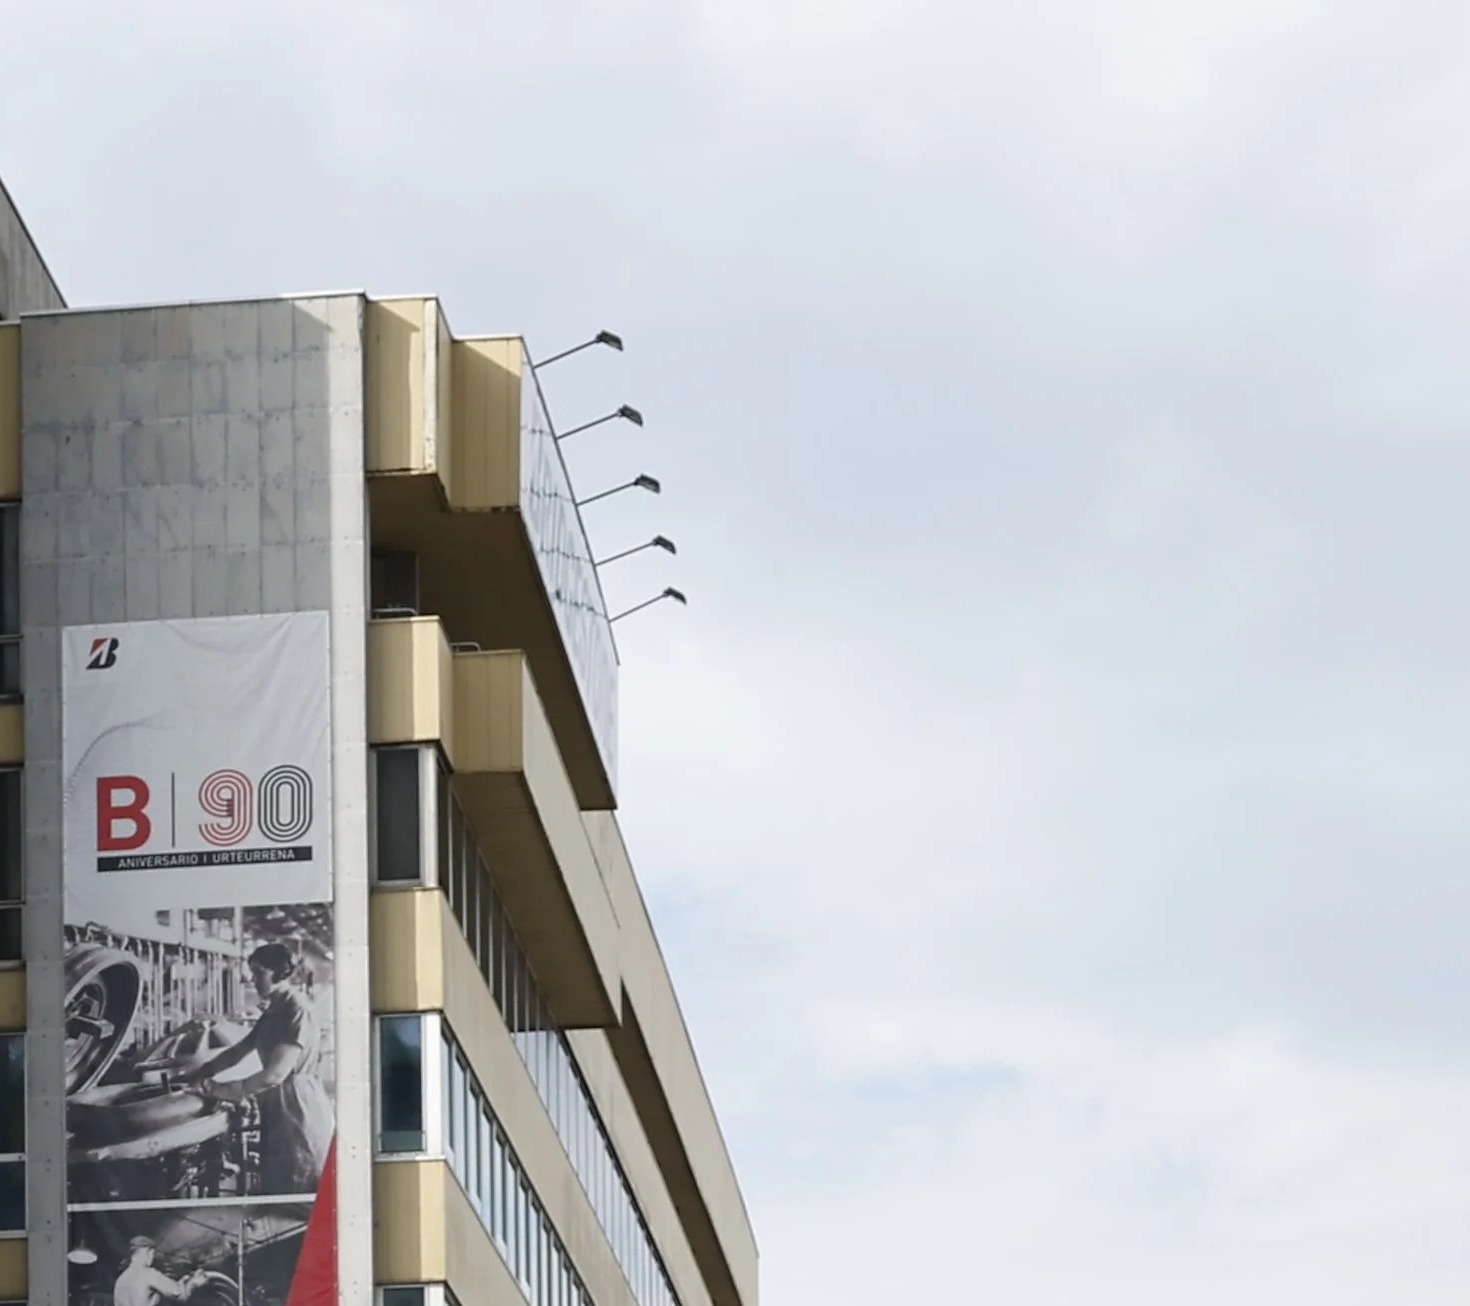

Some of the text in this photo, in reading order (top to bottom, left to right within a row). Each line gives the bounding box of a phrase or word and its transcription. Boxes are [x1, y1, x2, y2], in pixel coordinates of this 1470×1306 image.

[96, 764, 313, 852] B 90
[118, 849, 296, 869] ANIVERSARIO URTEURRENA
